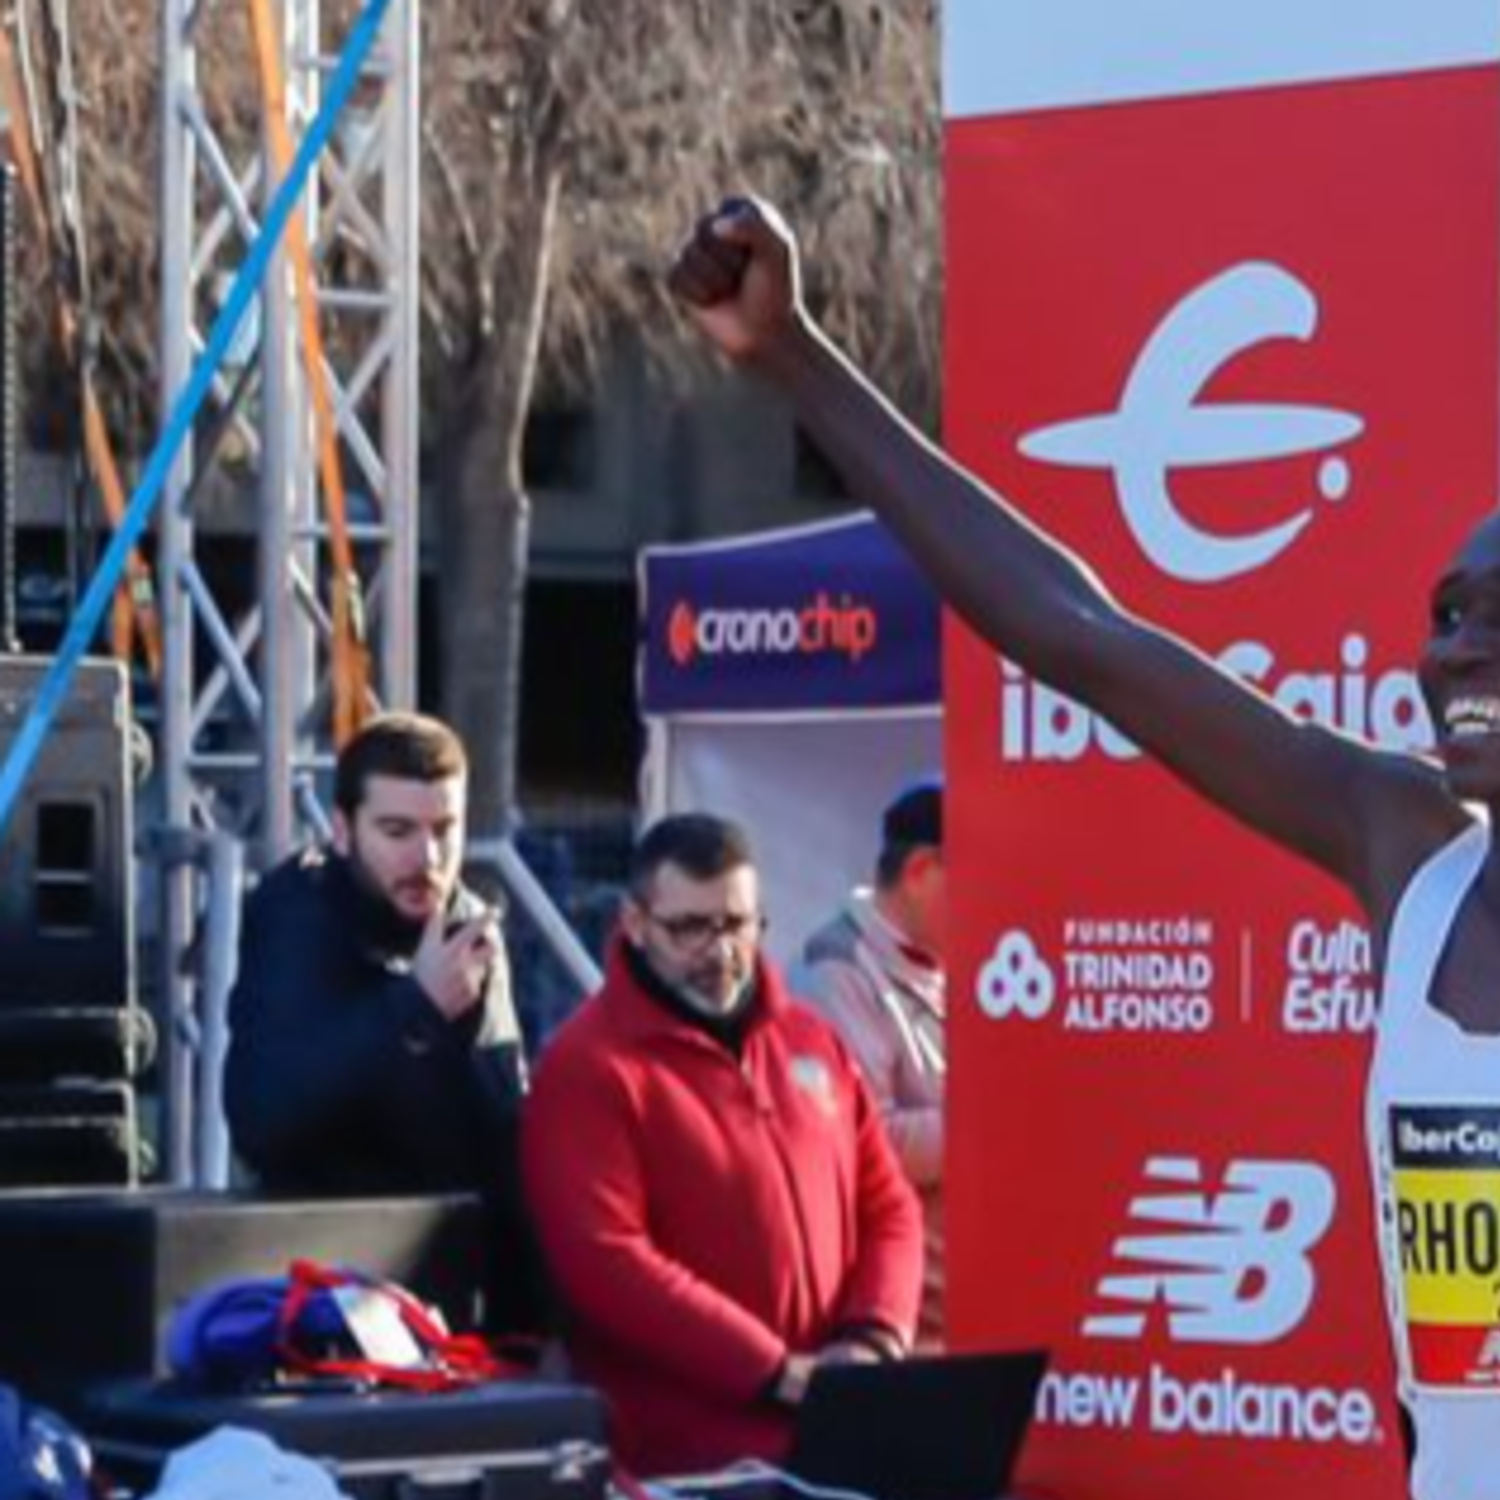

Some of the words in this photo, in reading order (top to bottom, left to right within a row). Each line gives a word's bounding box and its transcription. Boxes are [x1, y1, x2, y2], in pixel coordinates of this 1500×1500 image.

[1064, 952, 1214, 990] TRINIDAD
[1288, 918, 1371, 973] Cult
[1064, 993, 1214, 1032] ALFONSO
[1282, 975, 1375, 1032] Esfu
[1034, 1370, 1138, 1427] new
